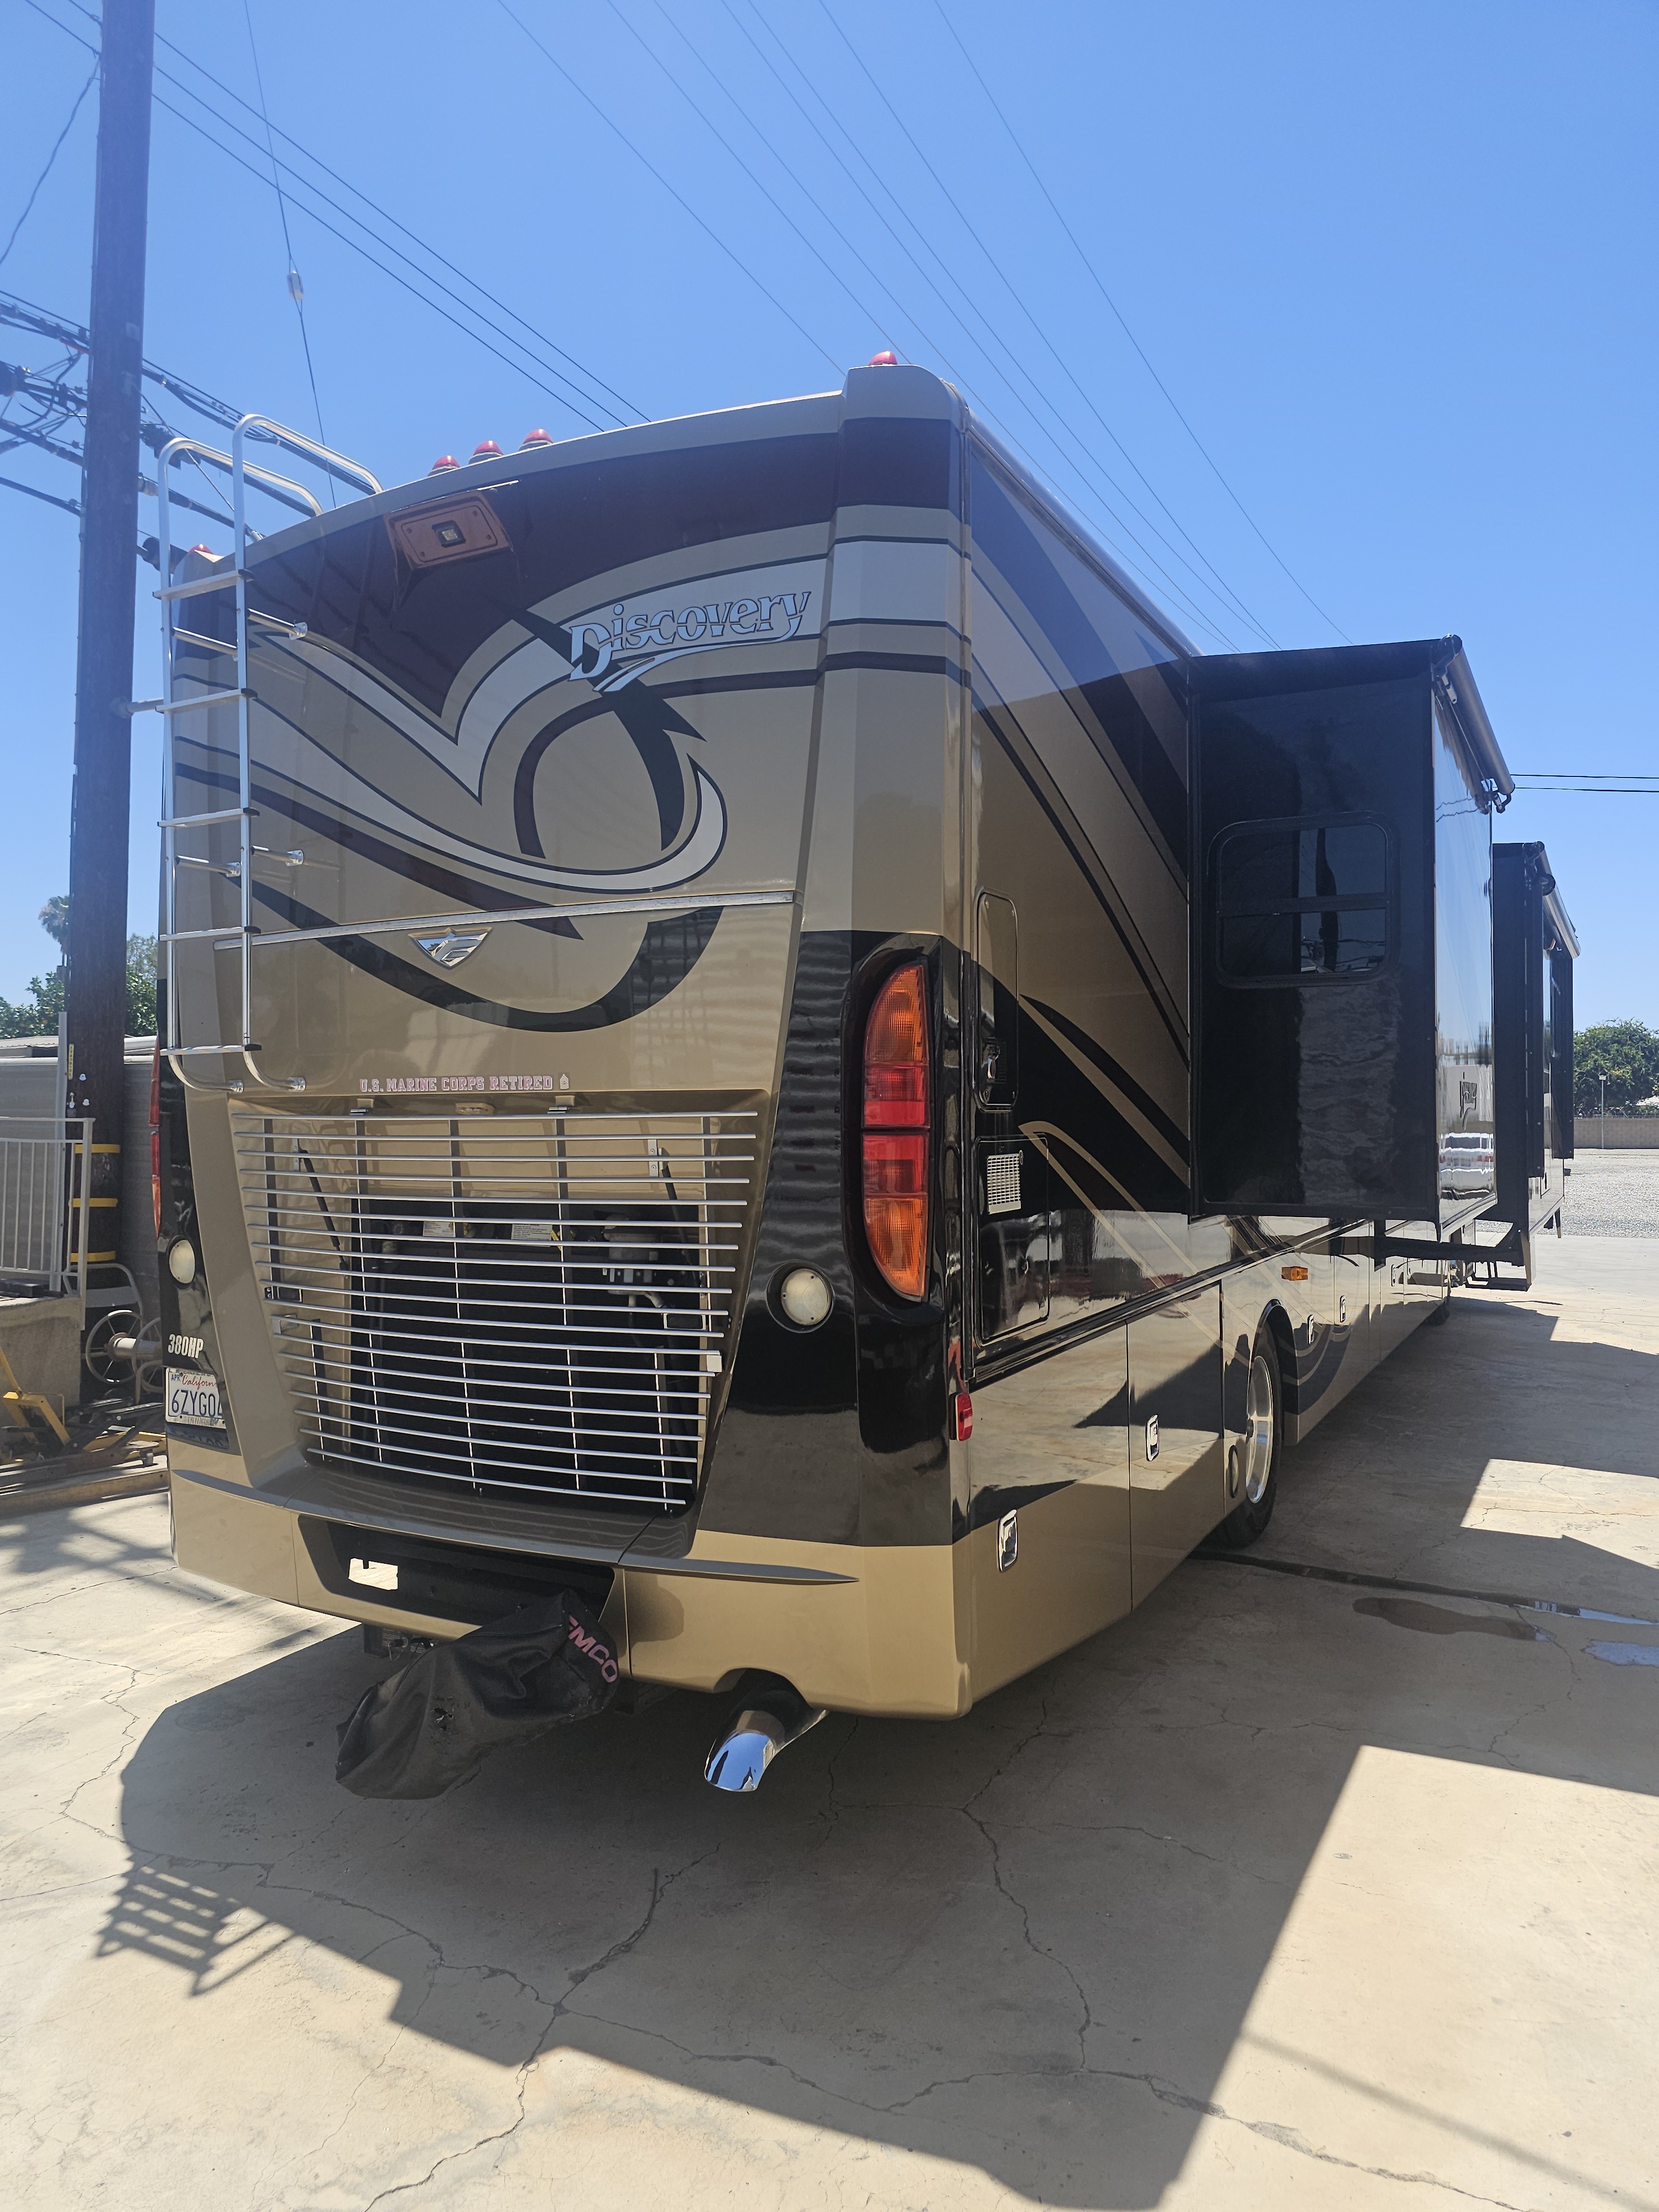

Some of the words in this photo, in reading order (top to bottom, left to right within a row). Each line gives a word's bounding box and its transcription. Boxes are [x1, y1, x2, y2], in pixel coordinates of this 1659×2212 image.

[568, 591, 811, 691] Discovery
[359, 1079, 384, 1092] U.S.
[387, 1078, 437, 1092] MARINE
[441, 1077, 484, 1091] CORPS
[489, 1076, 553, 1091] RETIRED
[168, 1334, 204, 1359] 380HP
[181, 1375, 217, 1390] Californ
